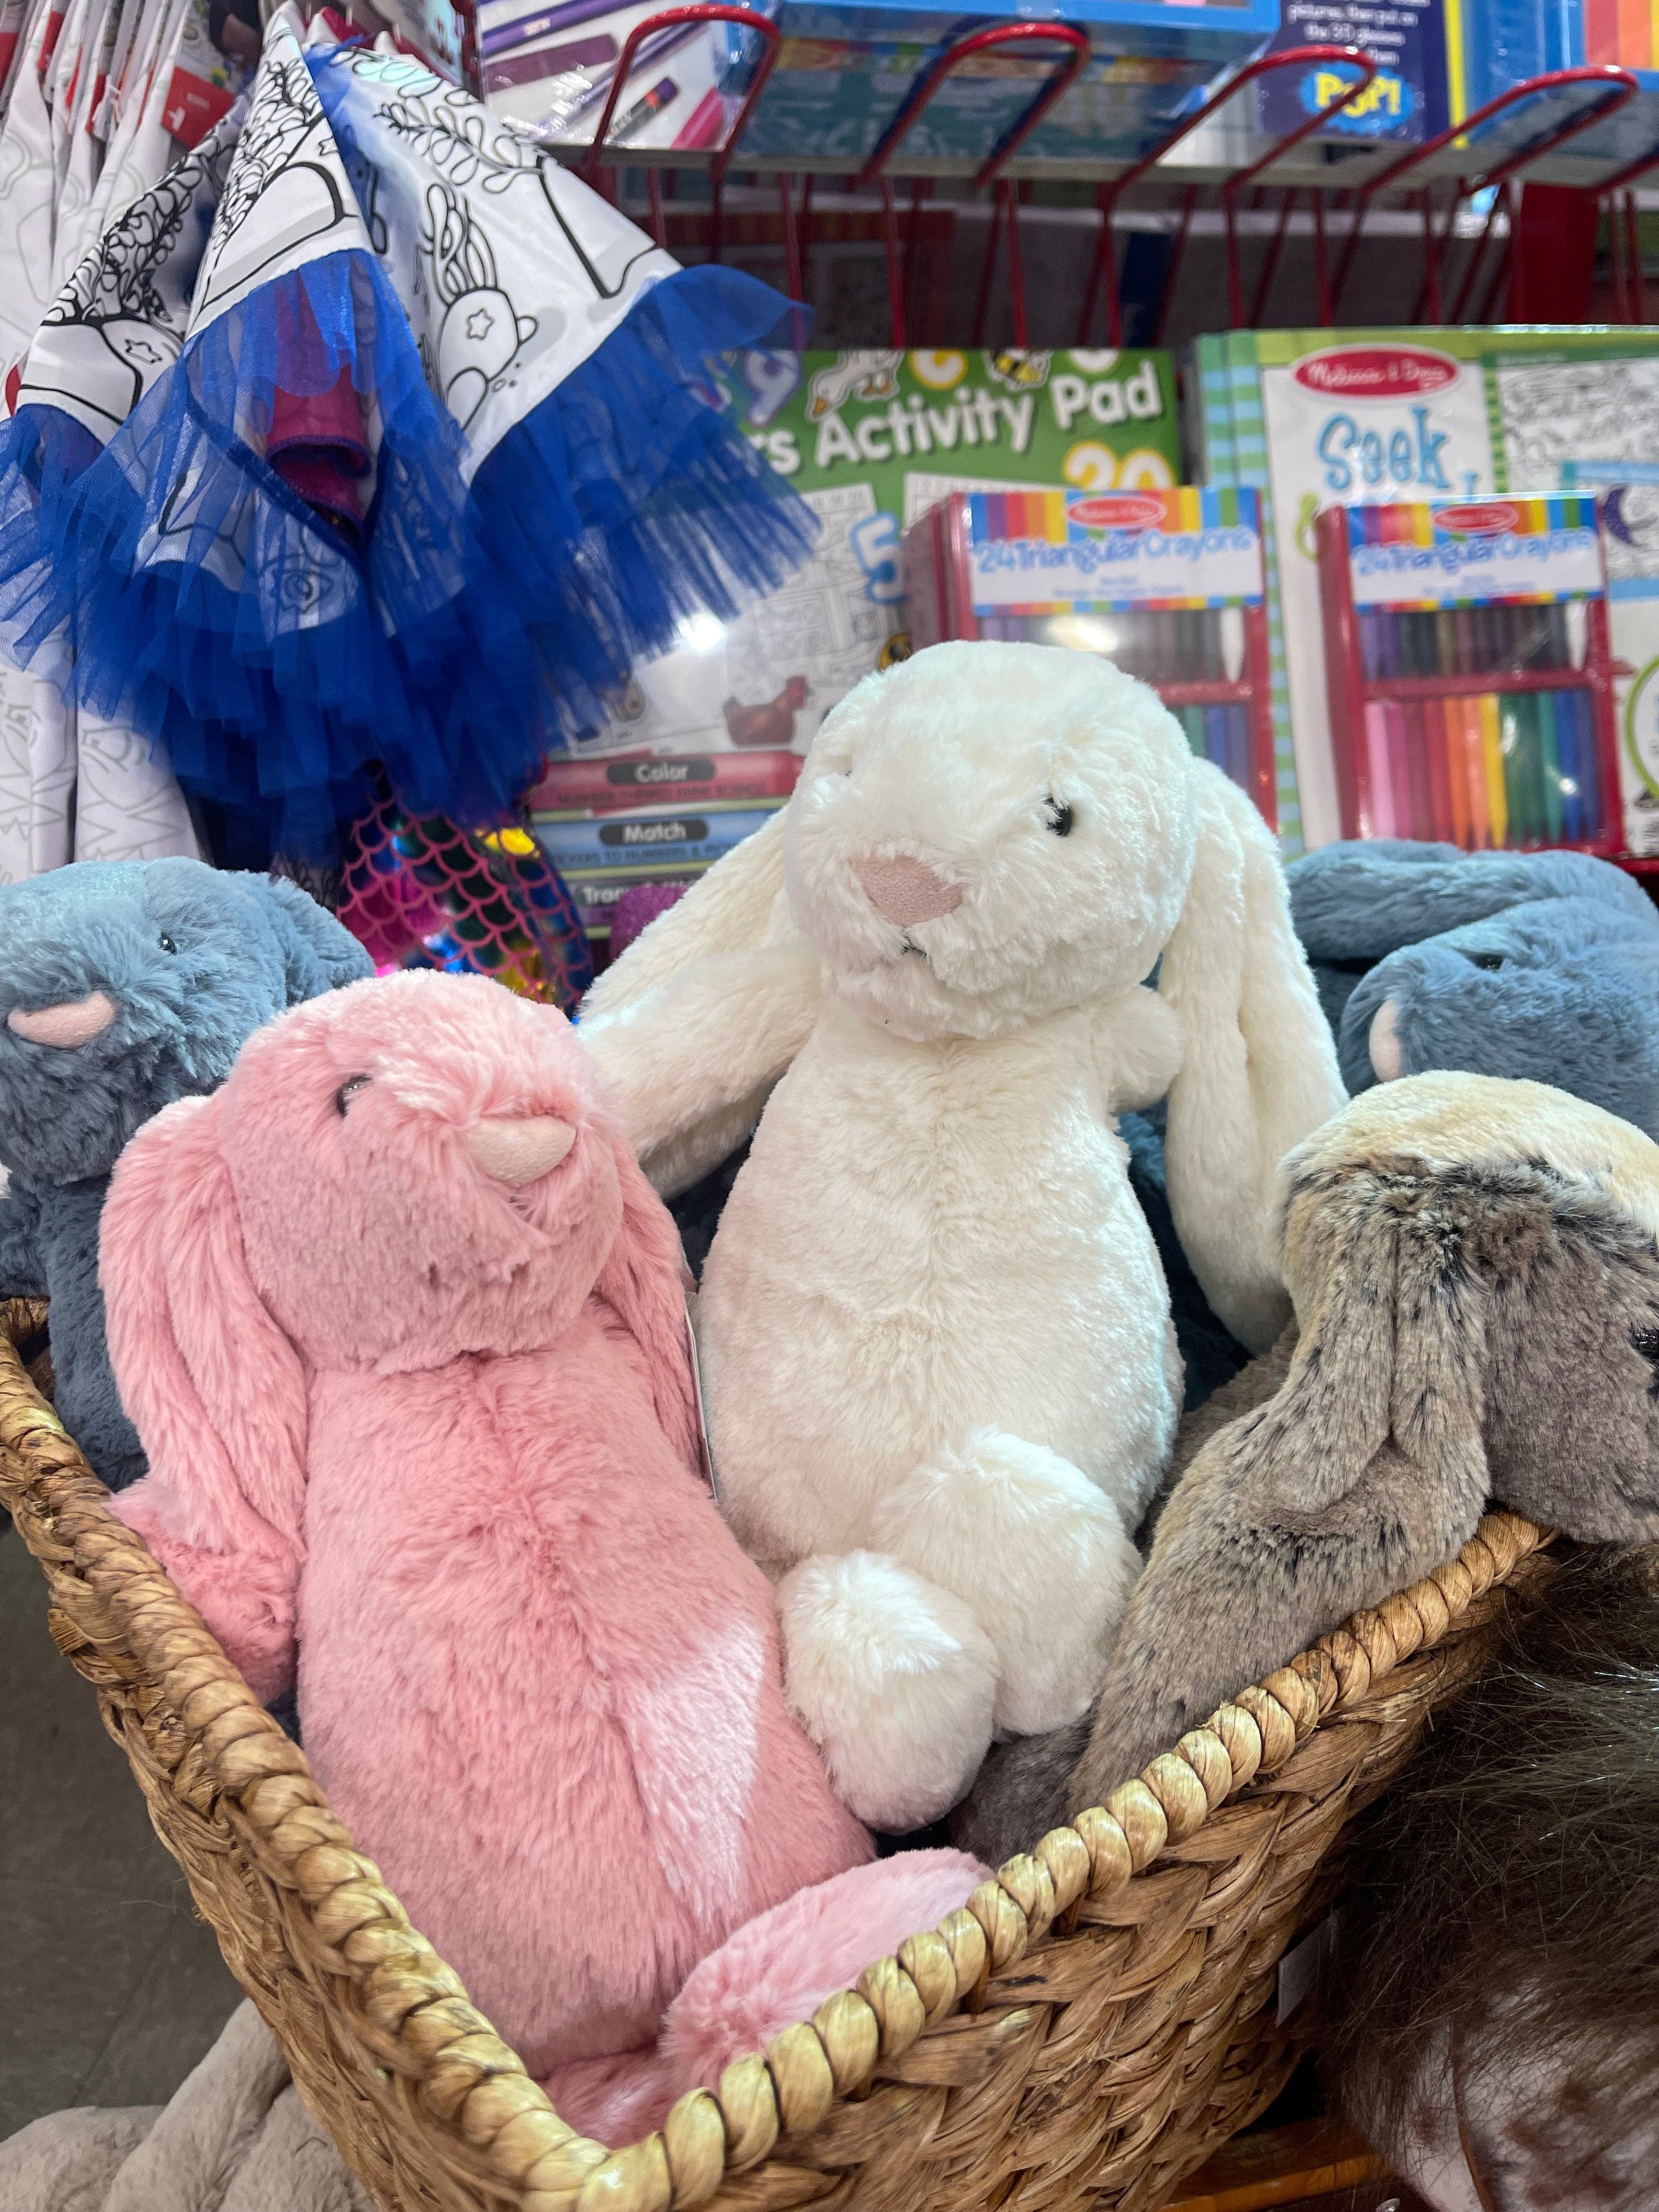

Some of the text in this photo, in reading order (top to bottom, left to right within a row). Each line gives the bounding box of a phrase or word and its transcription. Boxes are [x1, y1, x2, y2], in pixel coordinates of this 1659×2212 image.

[815, 386, 1035, 468] Activity
[1050, 360, 1162, 428] Pad
[1315, 404, 1452, 491] Seek
[633, 763, 688, 783] Color
[622, 822, 687, 844] Match
